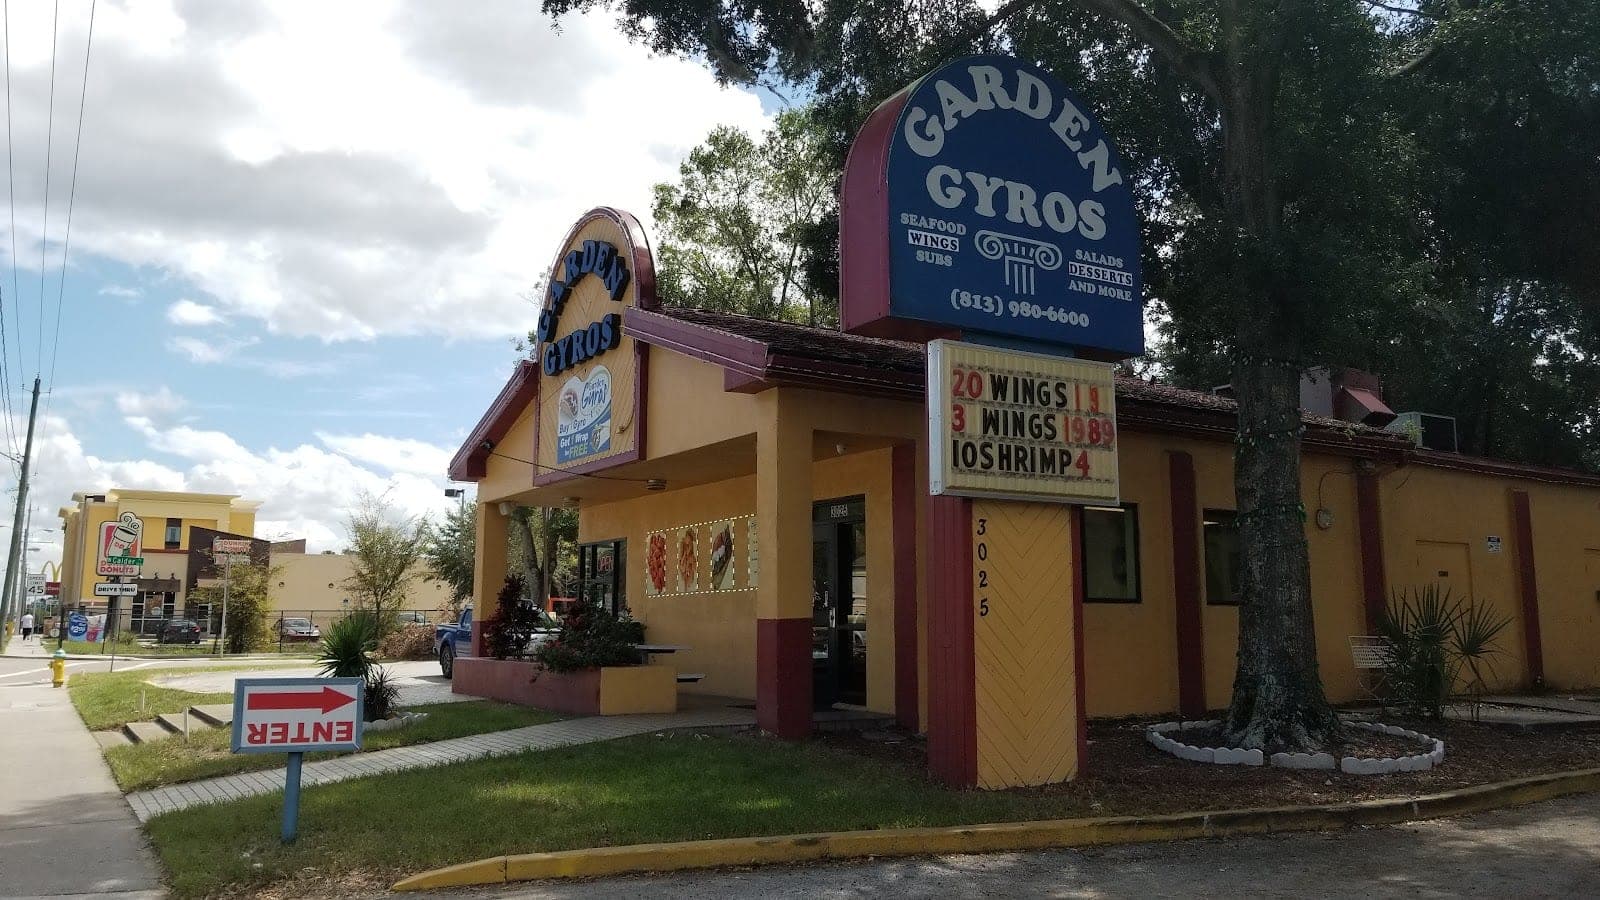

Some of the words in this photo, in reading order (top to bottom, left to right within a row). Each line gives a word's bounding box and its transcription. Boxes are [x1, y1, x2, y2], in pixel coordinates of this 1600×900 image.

[905, 66, 1122, 192] GARDEN
[926, 165, 1107, 240] GYROS
[900, 212, 967, 235] SEAFOOD
[909, 231, 958, 251] WINGS
[916, 250, 953, 267] SUBS
[1075, 249, 1123, 268] SALADS
[1069, 262, 1132, 286] DESSERTS
[538, 239, 630, 343] GARDEN
[1068, 279, 1096, 295] AND
[1098, 284, 1133, 301] MORE
[951, 288, 1004, 317] (813)
[1008, 301, 1090, 327] 980-6600
[544, 313, 621, 376] GYROS
[952, 368, 983, 399] 20
[989, 373, 1067, 408] WINGS
[951, 404, 965, 432] 3
[982, 407, 1057, 441] WINGS
[560, 436, 570, 448] Get
[575, 432, 588, 444] Wrap
[1075, 450, 1090, 478] 4
[597, 555, 614, 573] OPEN
[976, 518, 989, 617] 3025
[28, 585, 44, 594] 45
[246, 720, 354, 745] ENTER
